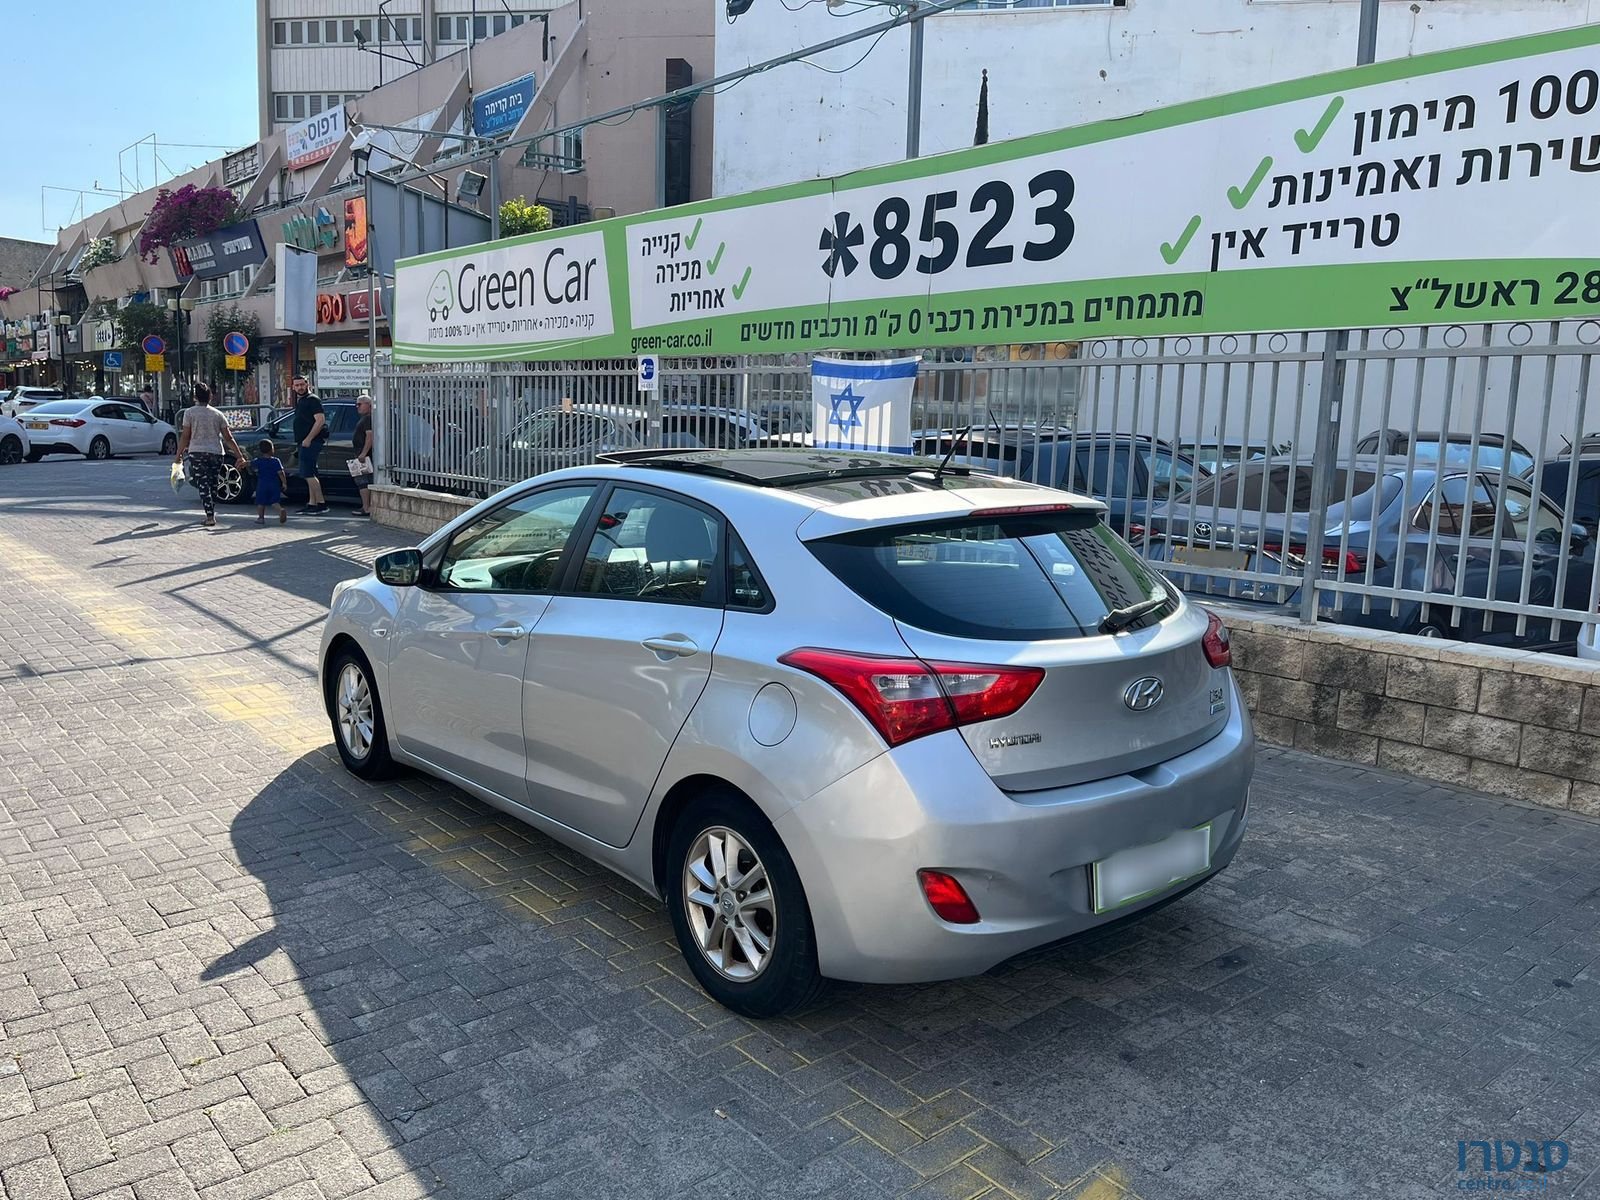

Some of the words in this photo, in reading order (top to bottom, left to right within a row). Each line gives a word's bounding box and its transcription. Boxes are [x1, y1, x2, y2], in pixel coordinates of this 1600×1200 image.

[509, 93, 523, 108] בית
[1499, 69, 1600, 124] 100
[308, 112, 338, 142] דפוס
[1353, 94, 1476, 156] מימון
[1457, 133, 1600, 186] שירות
[1268, 153, 1441, 209] ואמינות
[641, 231, 681, 260] קנייה
[1282, 211, 1400, 256] טרייד
[1211, 225, 1268, 273] אין
[458, 263, 534, 314] Green
[543, 247, 597, 303] Car
[656, 259, 701, 284] מכירה
[669, 287, 725, 313] אחריות
[1389, 277, 1540, 312] ראשל"צ
[1553, 270, 1600, 305] 28
[927, 306, 975, 333] רכבי
[981, 299, 1075, 331] במכירת
[1084, 289, 1204, 323] מתמחים
[428, 327, 444, 342] מימון
[444, 325, 462, 338] 100%
[463, 325, 472, 336] עד
[475, 323, 486, 339] אין
[487, 320, 506, 333] טרייד
[511, 318, 538, 332] אחריות
[544, 315, 568, 330] מכירה
[575, 313, 595, 331] קניה
[740, 318, 795, 342] חדשים
[801, 312, 858, 339] ורכבים
[907, 308, 921, 335] 0
[631, 332, 713, 353] green-car.co.il
[340, 350, 371, 363] Green
[989, 733, 1042, 749] HYUNDAI
